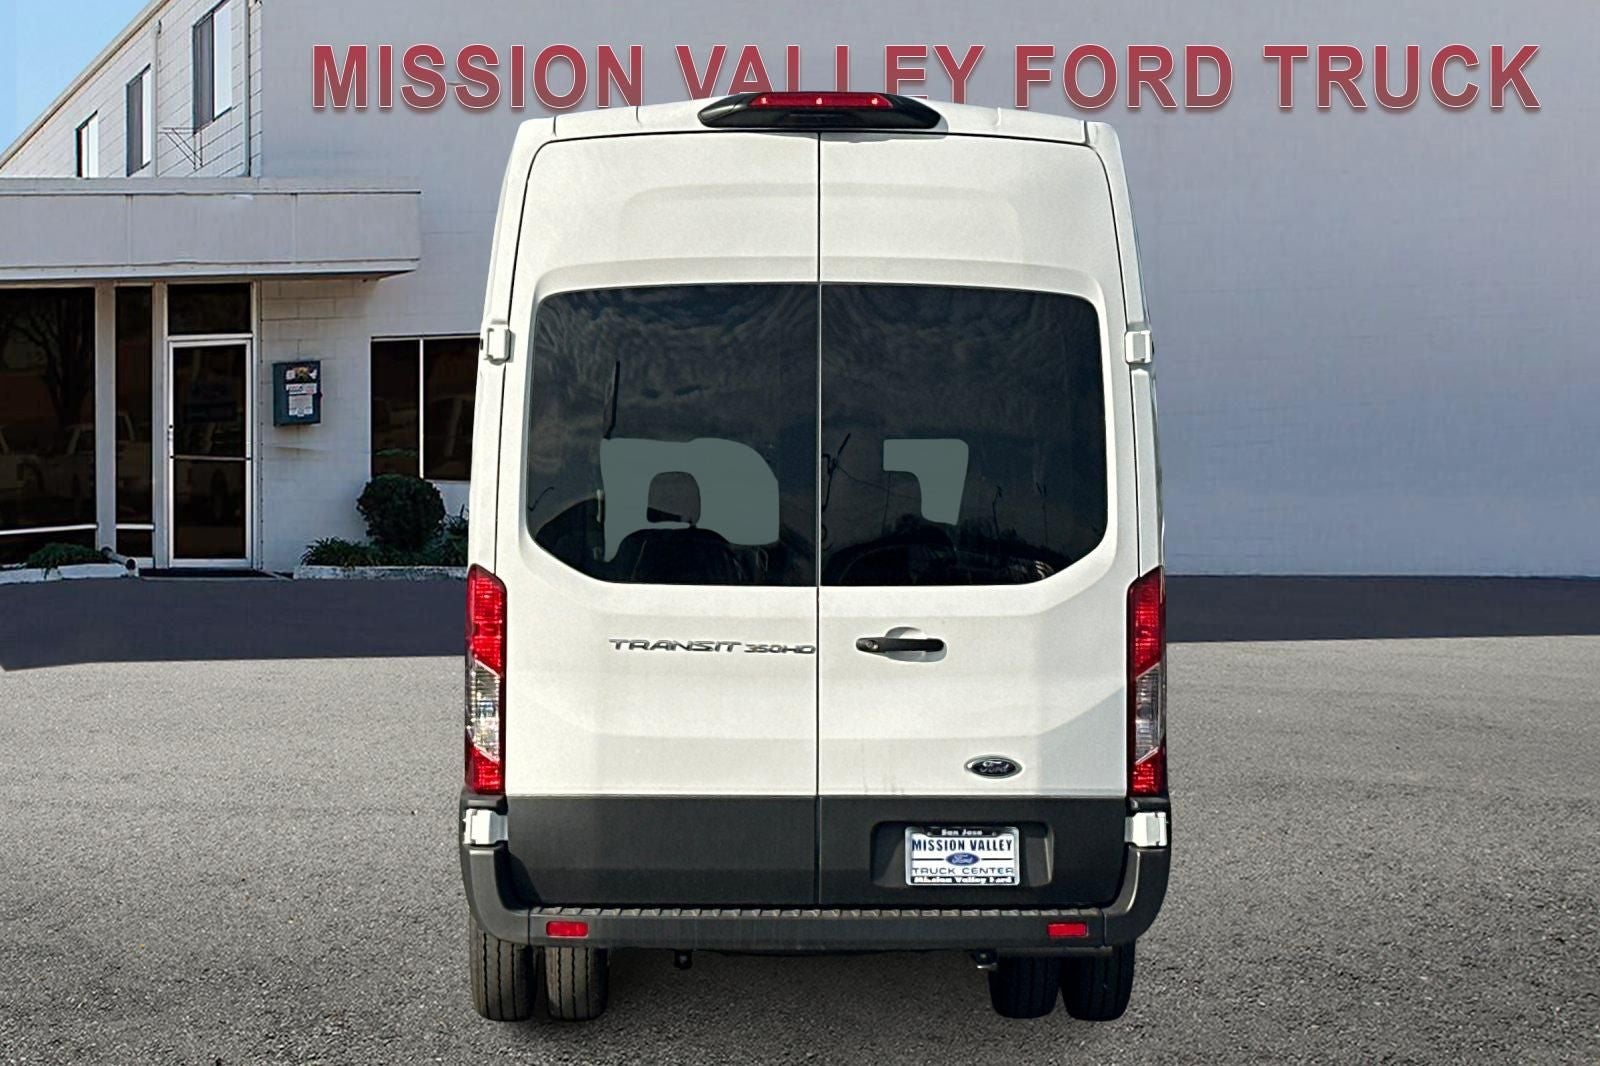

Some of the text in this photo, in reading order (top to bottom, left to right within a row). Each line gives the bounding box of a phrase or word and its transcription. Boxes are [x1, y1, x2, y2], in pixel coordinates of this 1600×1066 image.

[311, 44, 1542, 110] MISSION VALLEY FORD TRUCK
[609, 638, 816, 654] TRANSIT 350HD
[941, 828, 959, 836] San
[912, 839, 1013, 851] MISSION VALLEY
[912, 867, 1014, 875] TRUCK CENTER
